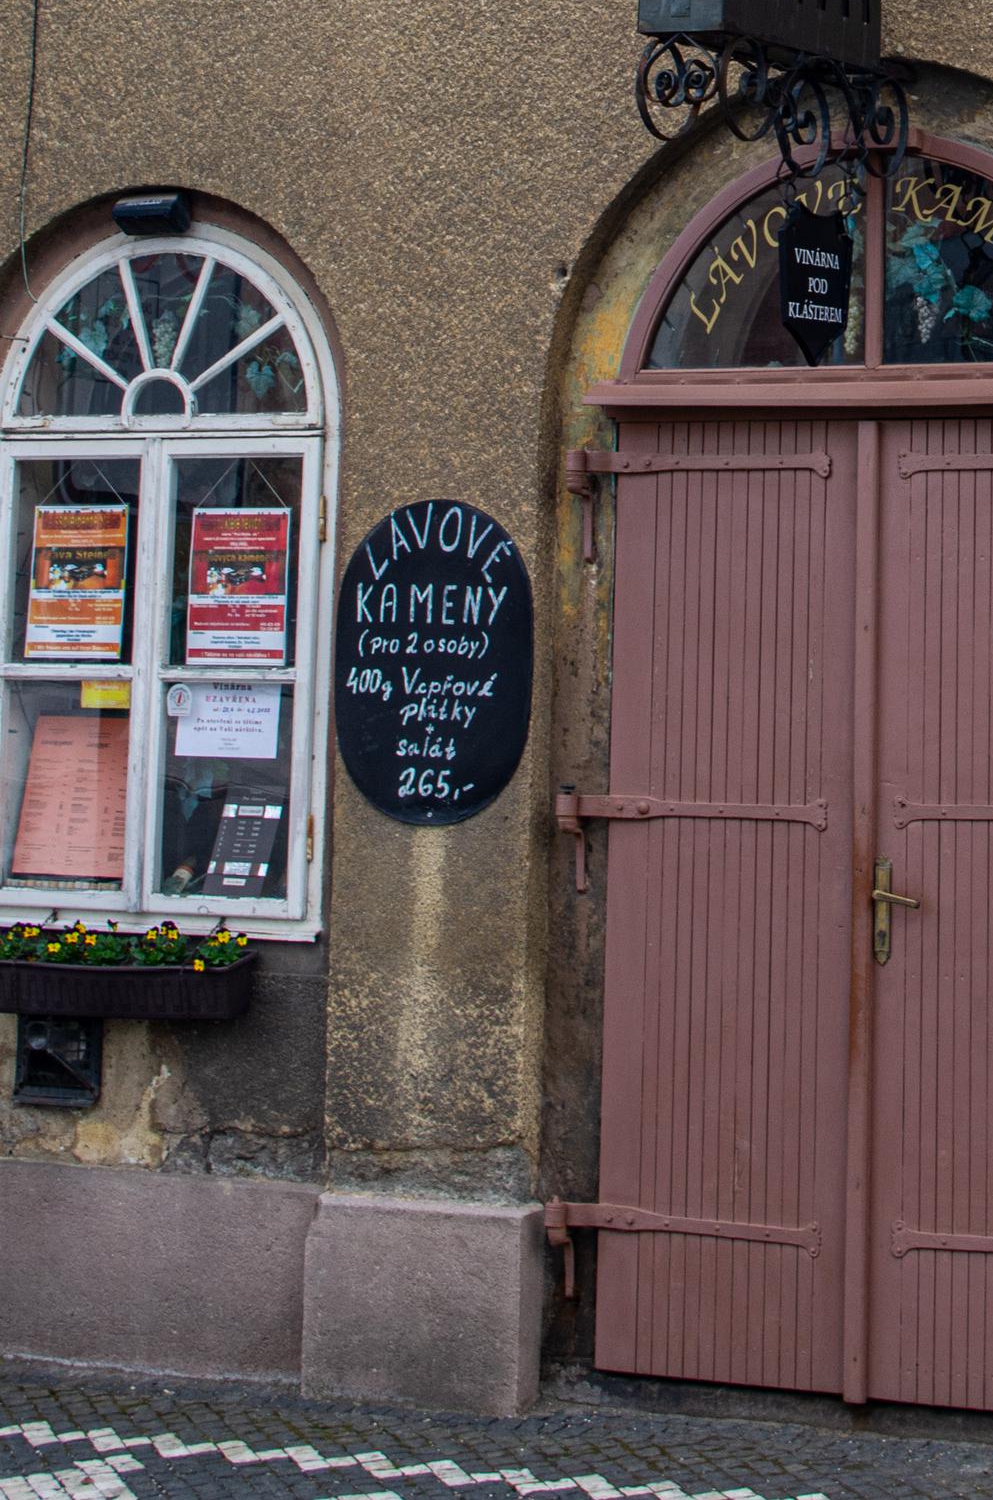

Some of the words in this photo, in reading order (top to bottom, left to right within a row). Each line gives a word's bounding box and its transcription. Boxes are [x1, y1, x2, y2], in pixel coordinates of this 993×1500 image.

[794, 247, 840, 270] VINÁRNA
[808, 277, 828, 295] POD
[788, 299, 842, 323] KLÁŠTEREM
[365, 502, 513, 583] LÁVOVÉ
[356, 582, 508, 626] KAMENY
[358, 629, 400, 658] (pro
[405, 632, 418, 655] 2
[423, 631, 489, 660] osoby)
[346, 666, 393, 701] 400g
